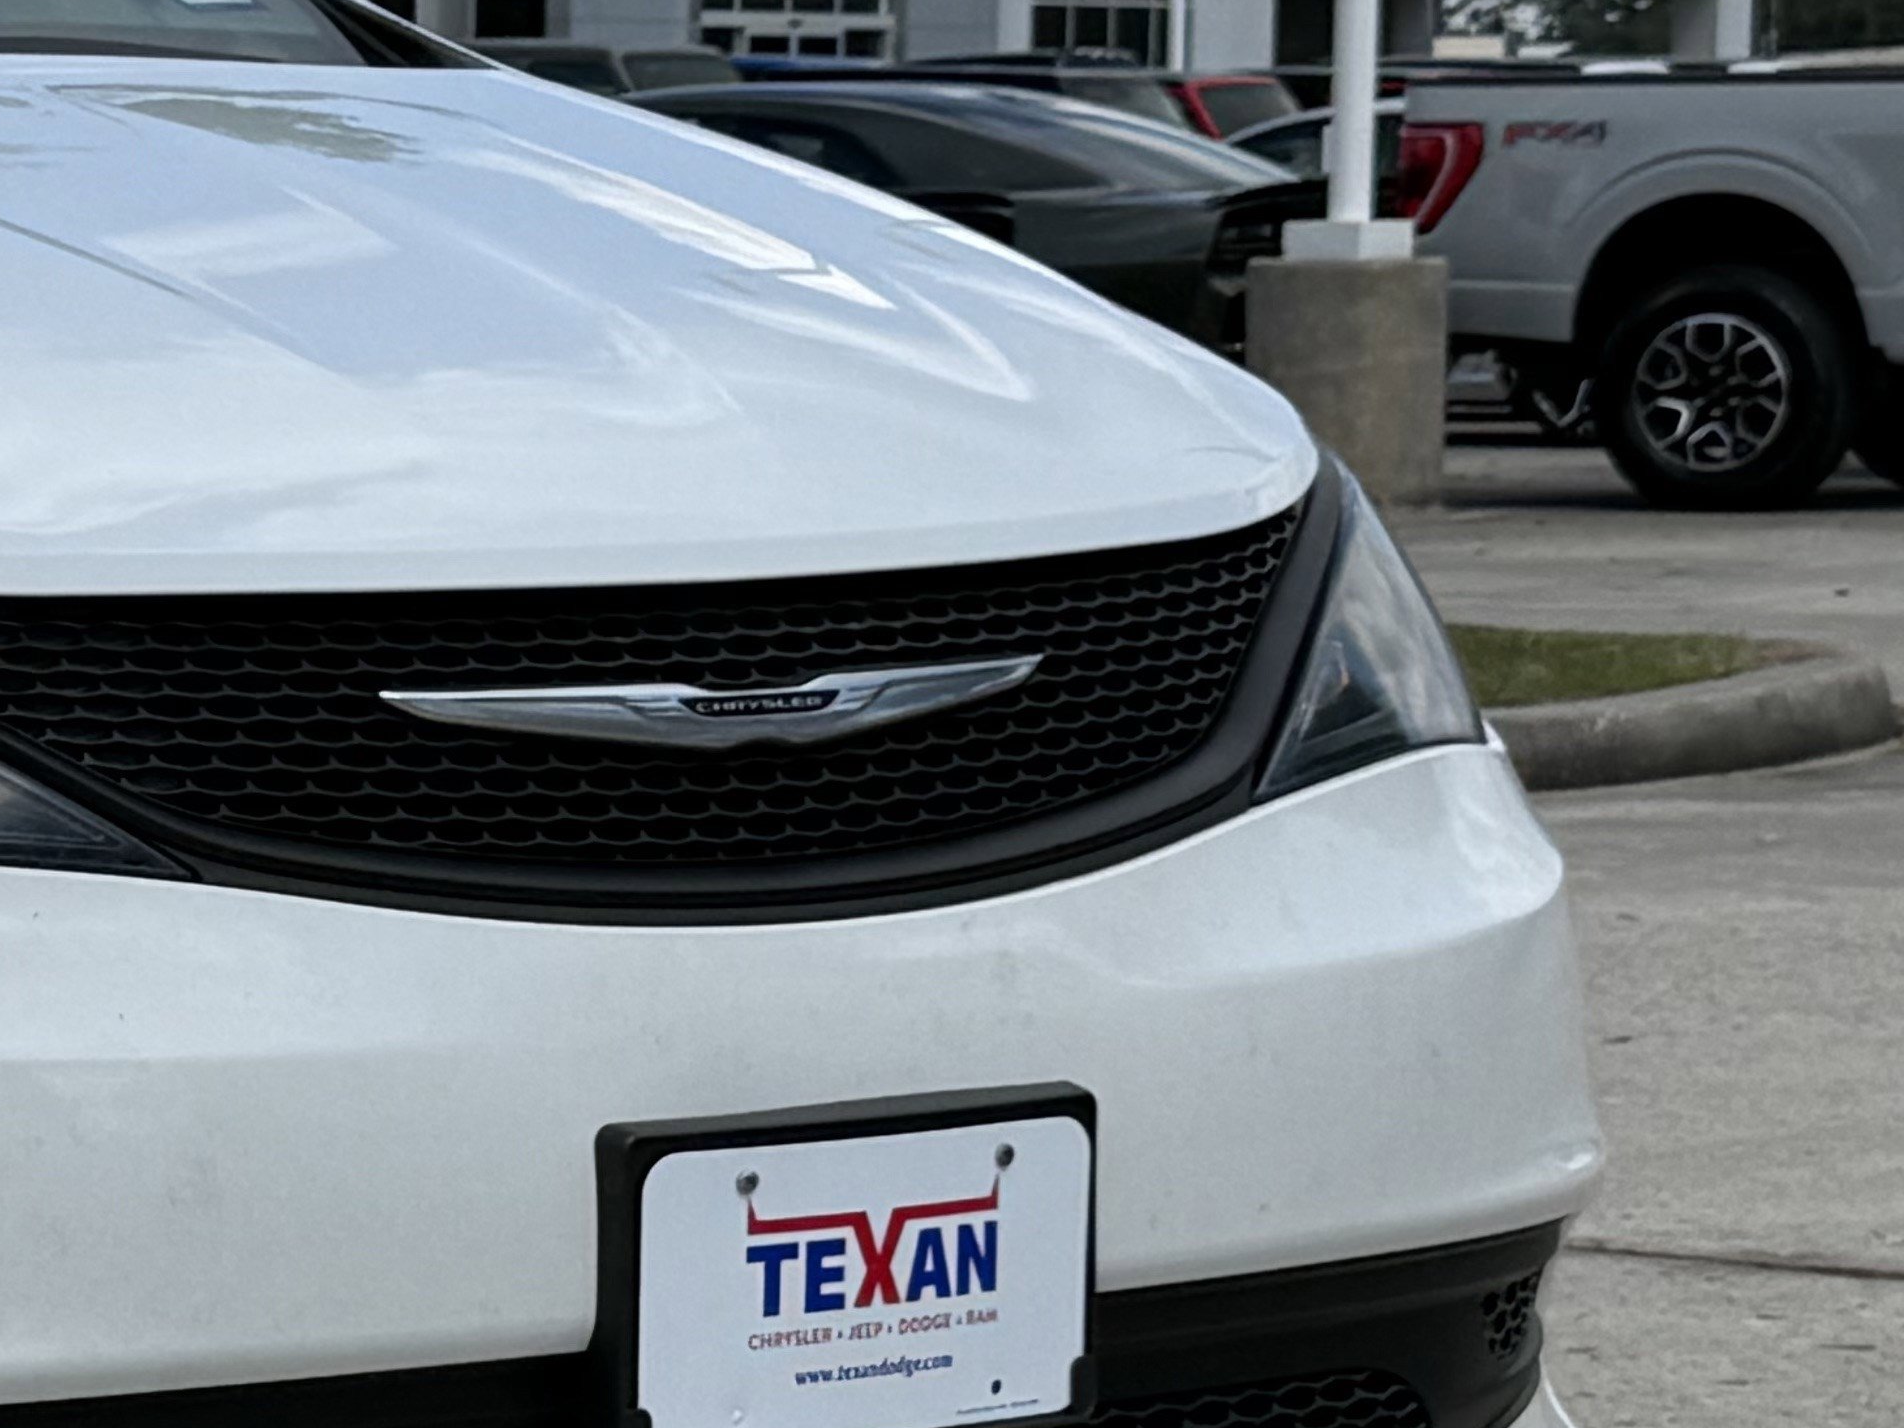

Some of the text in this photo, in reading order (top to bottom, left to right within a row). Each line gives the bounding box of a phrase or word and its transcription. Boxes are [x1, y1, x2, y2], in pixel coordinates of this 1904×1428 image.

[745, 1192, 998, 1318] TEXAN
[748, 1309, 999, 1351] CHRYSLER JEEP DODGE RAM
